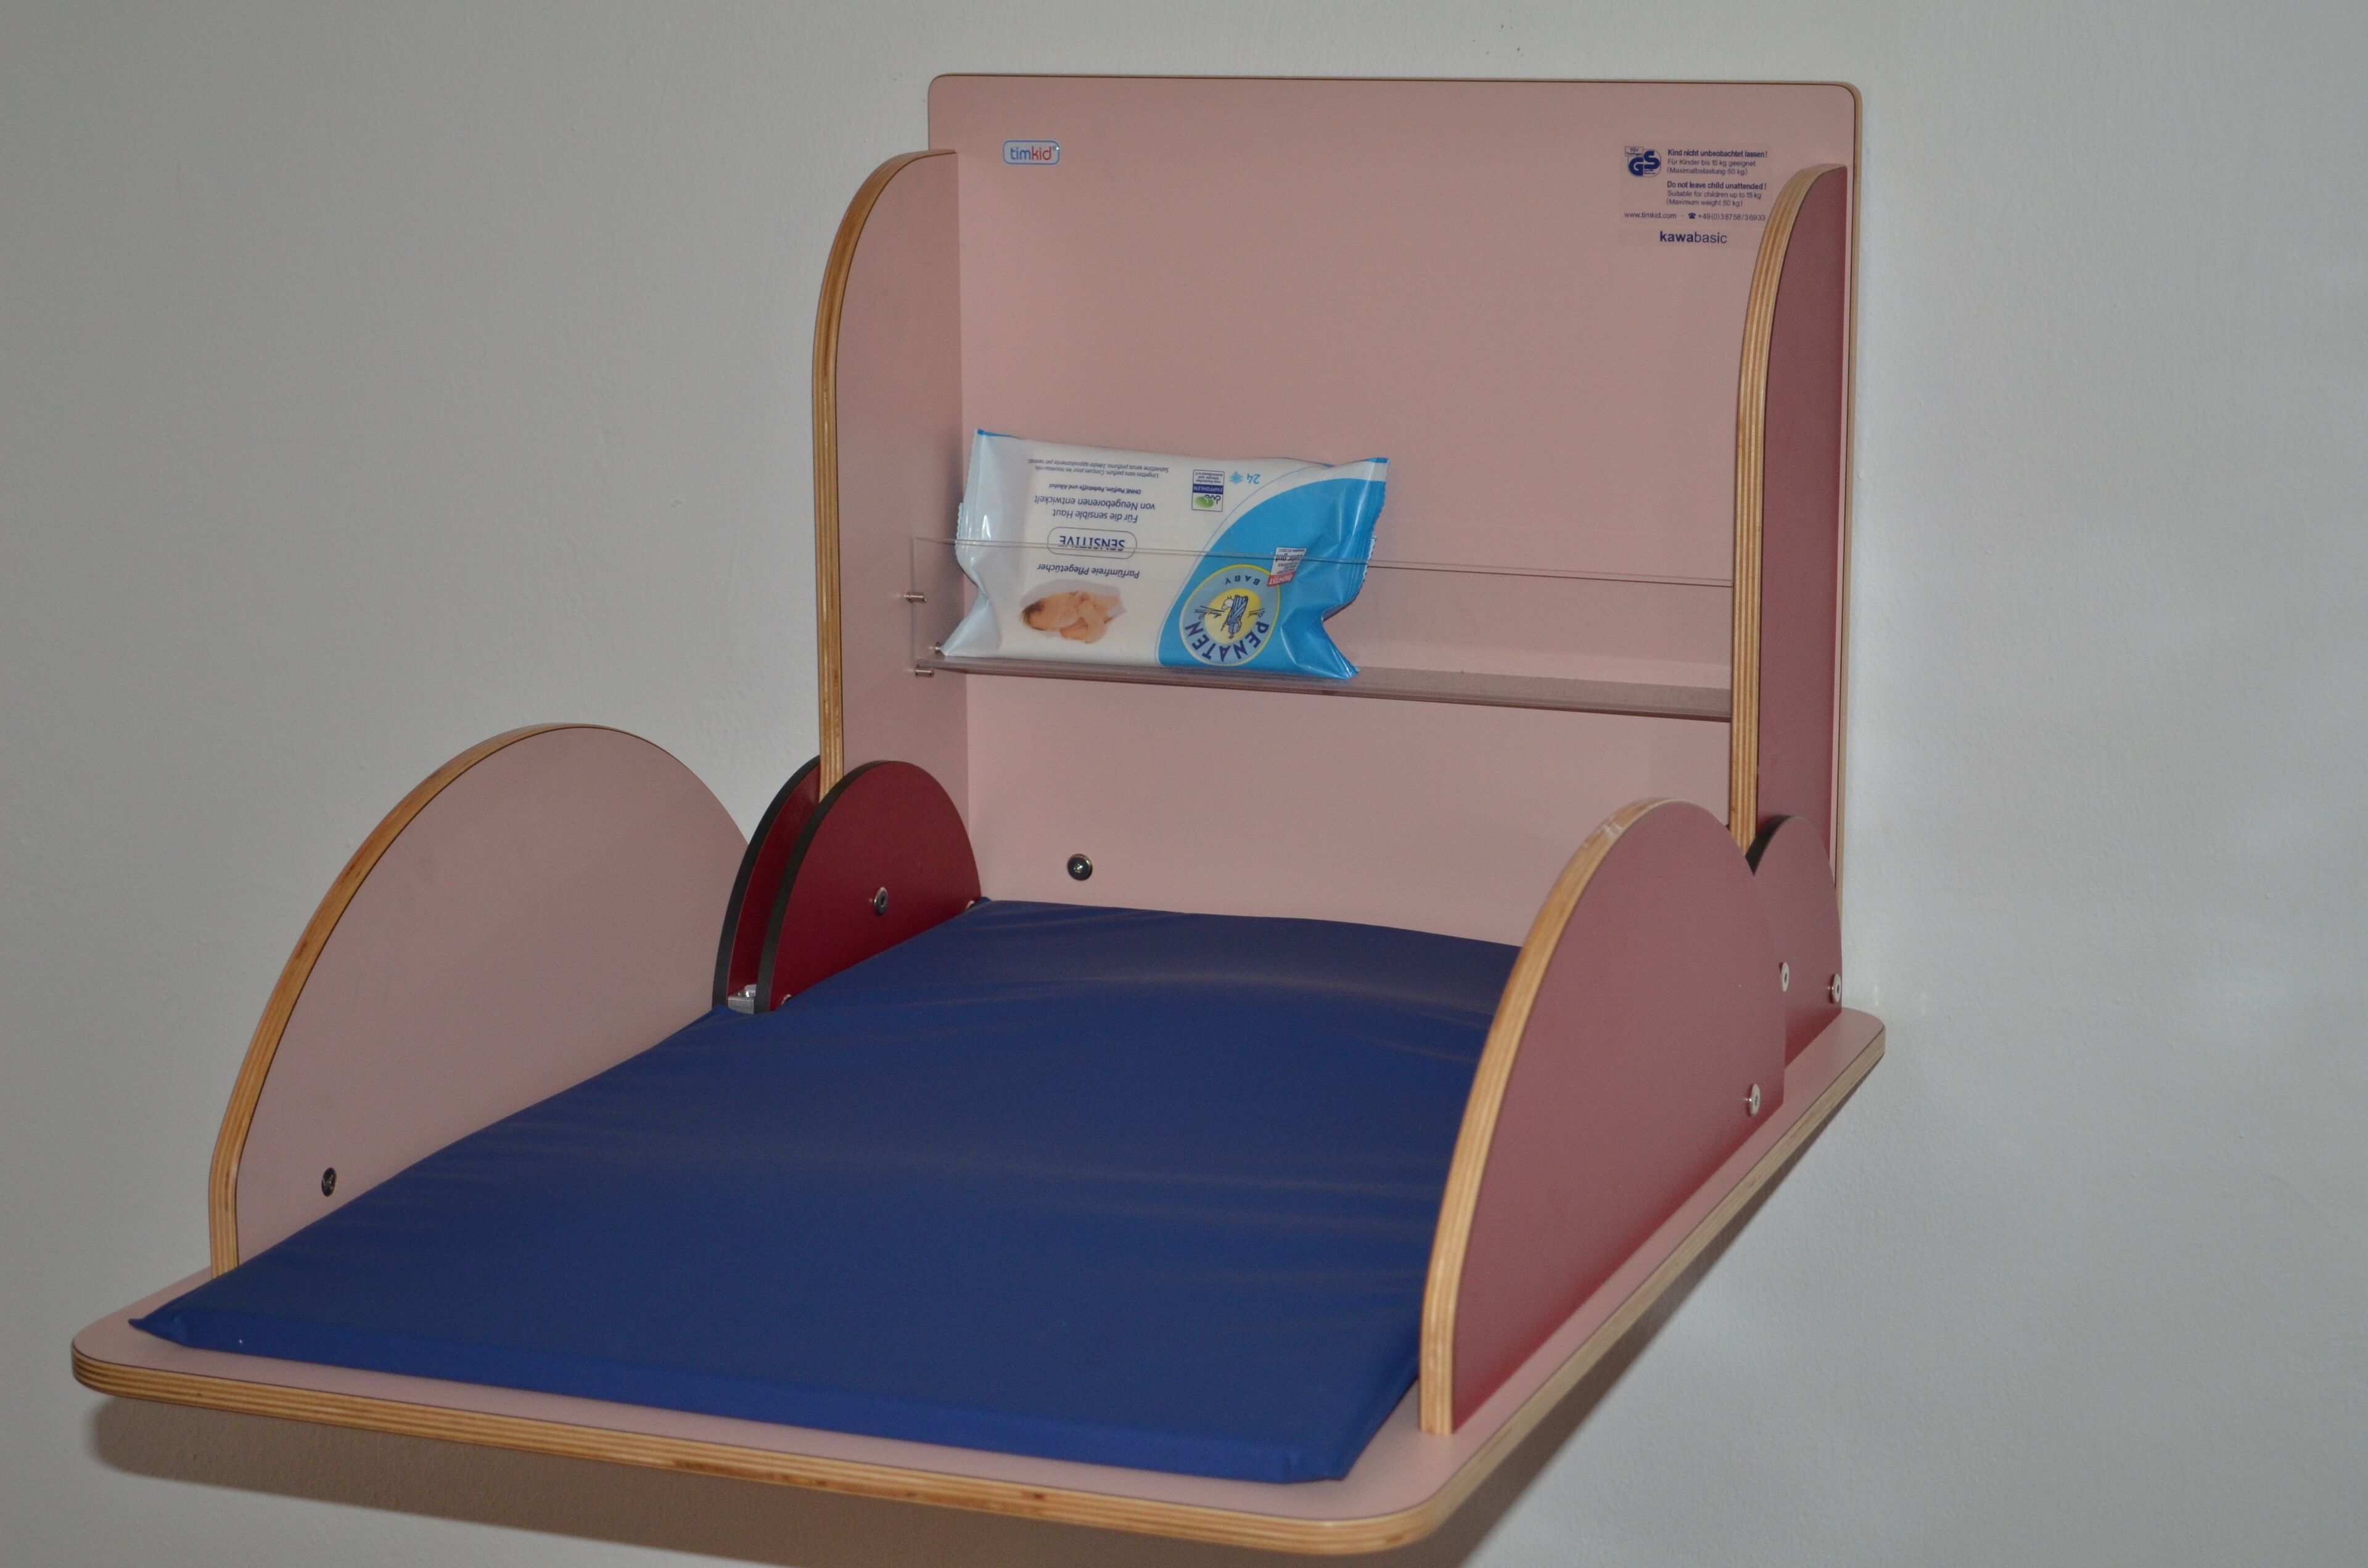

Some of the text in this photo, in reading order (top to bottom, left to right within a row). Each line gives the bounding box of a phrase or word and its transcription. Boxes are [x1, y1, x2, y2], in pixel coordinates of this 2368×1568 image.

[1010, 146, 1051, 160] timkid
[1660, 231, 1727, 244] kawabasic
[1247, 474, 1260, 484] 24
[1034, 495, 1075, 506] entwickelt
[1078, 498, 1138, 511] Neugeborenen
[1052, 509, 1138, 523] Für die sensible Haut
[1058, 536, 1125, 552] SENSITIVE
[1275, 553, 1286, 562] gut
[1037, 564, 1140, 579] Parfümfreie Pflegetücher
[1225, 575, 1260, 586] BABY
[1184, 621, 1269, 663] PENATEN
